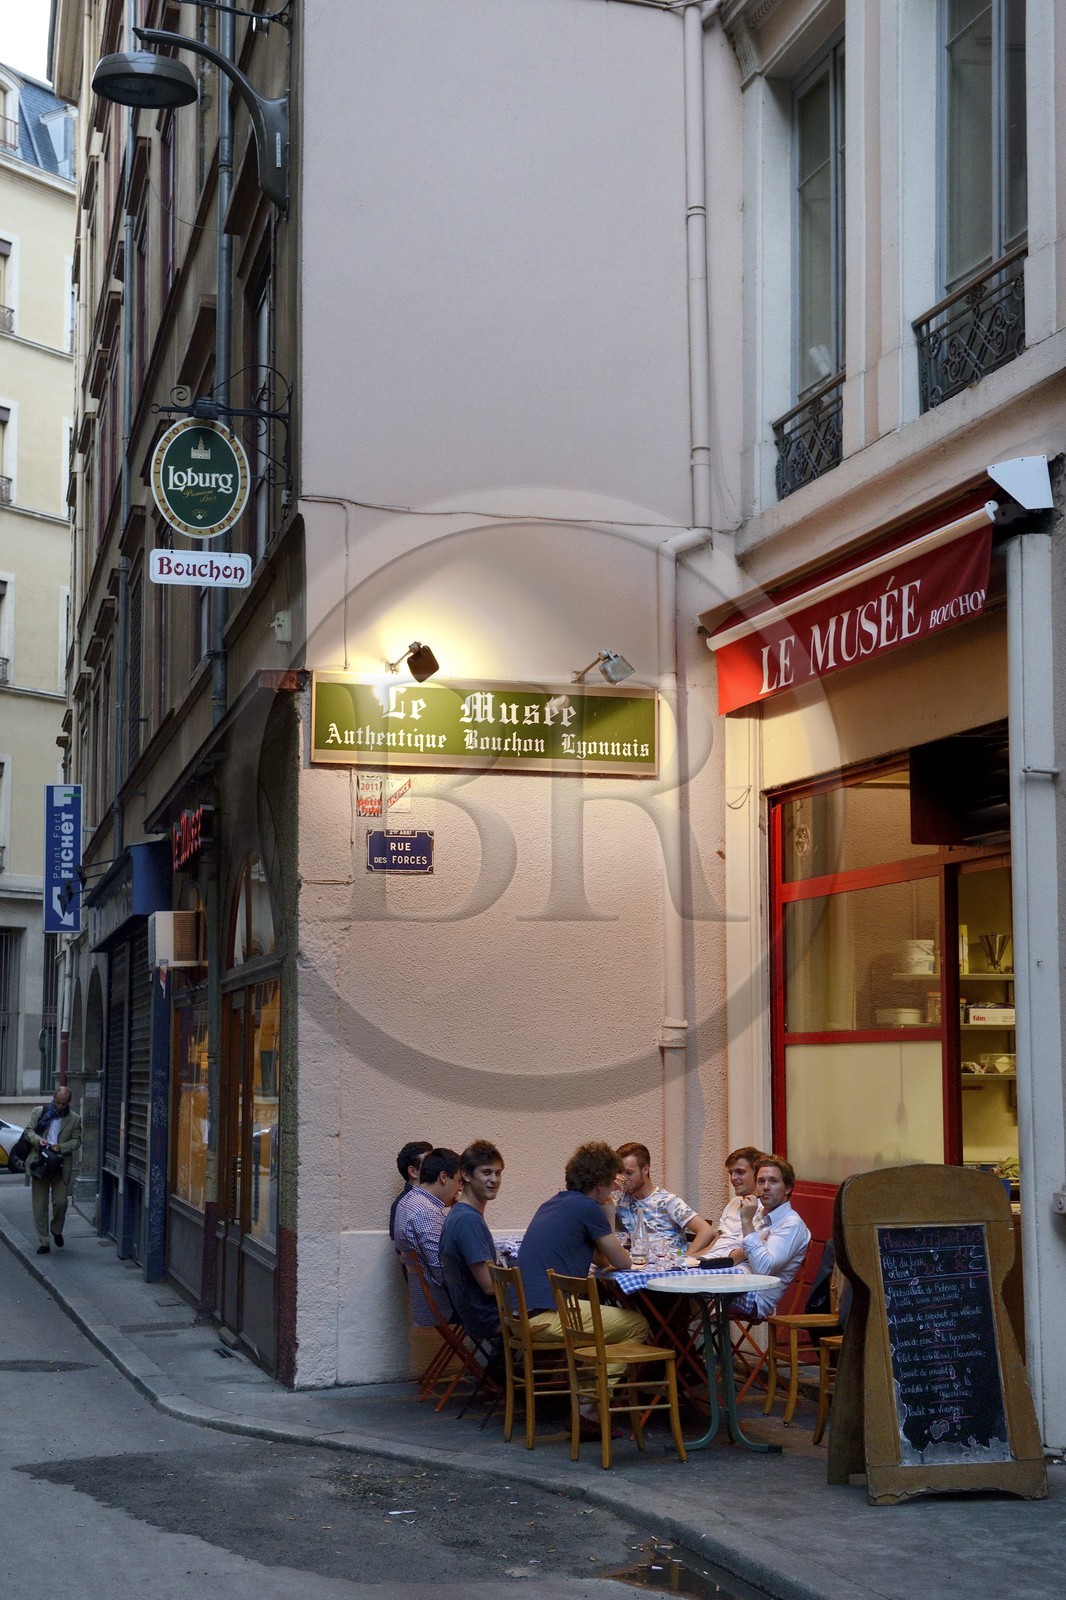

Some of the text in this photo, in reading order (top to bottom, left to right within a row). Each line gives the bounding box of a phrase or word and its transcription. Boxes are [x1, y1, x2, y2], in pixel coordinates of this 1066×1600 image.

[154, 421, 190, 474] LONDON
[168, 466, 234, 494] Loburg
[158, 498, 188, 532] PARIS
[209, 506, 240, 534] ROMA
[158, 556, 246, 583] Bouchon
[758, 576, 923, 695] LE MUSÉE
[380, 685, 428, 720] Le
[324, 722, 650, 760] Authentique Bouchon Lyonnais
[374, 855, 428, 865] DES FORCES
[390, 842, 411, 851] RUE
